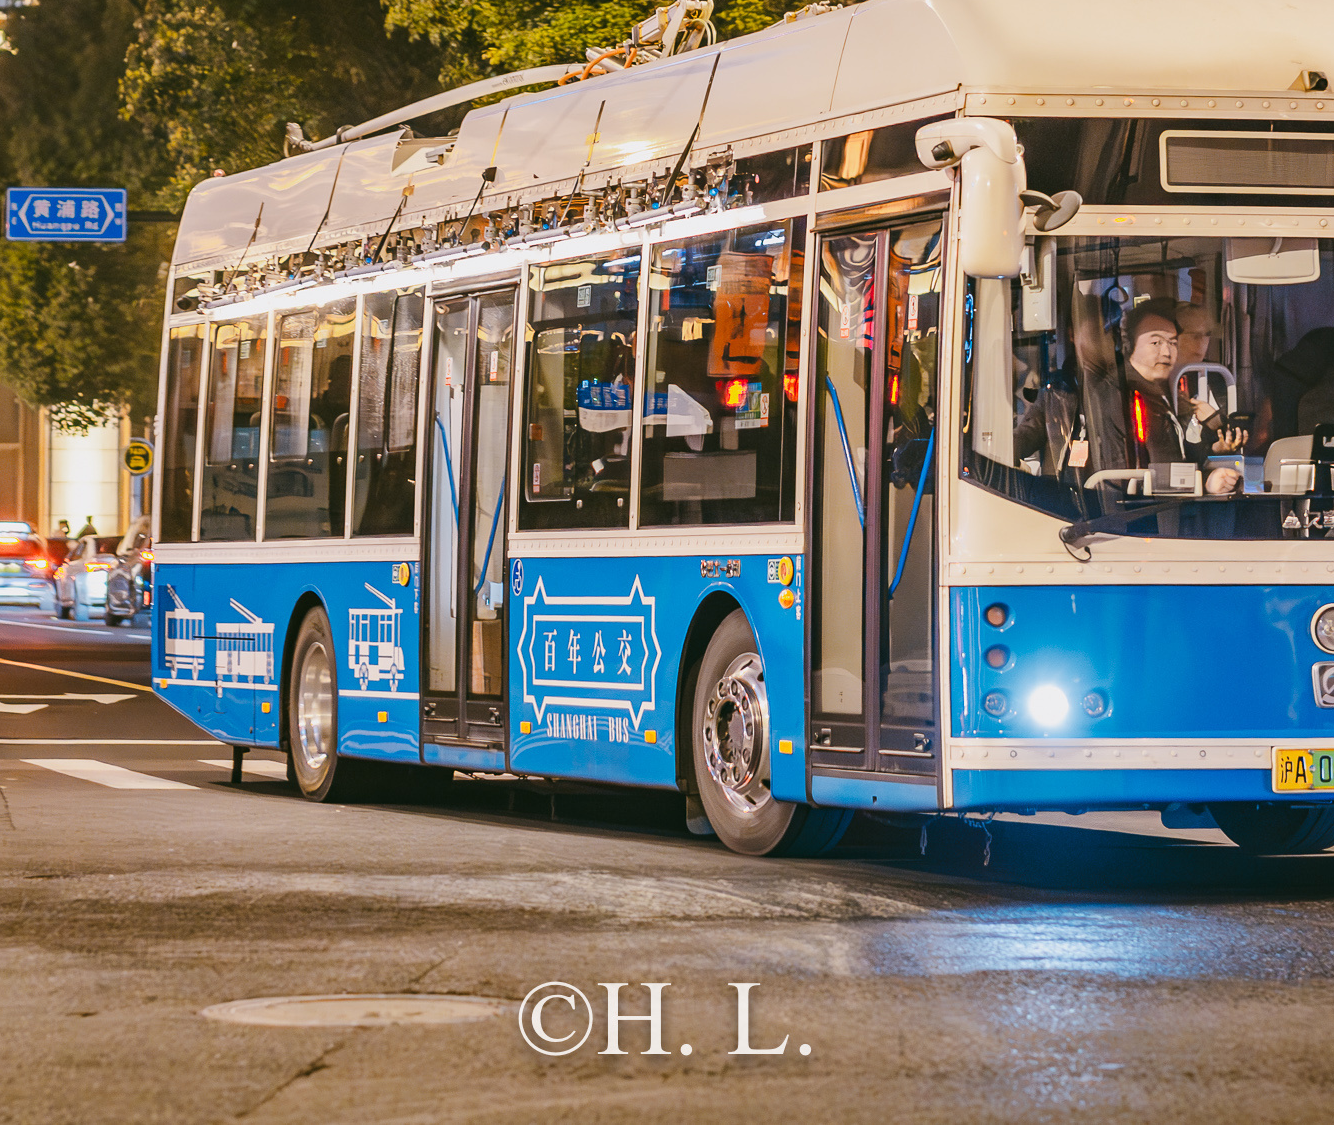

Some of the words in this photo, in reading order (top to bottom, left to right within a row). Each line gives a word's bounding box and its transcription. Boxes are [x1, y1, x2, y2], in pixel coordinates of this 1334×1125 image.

[33, 199, 100, 219] 黄浦路
[543, 628, 633, 676] 百年公交
[546, 712, 598, 741] SHANGHAI
[608, 716, 629, 743] BUS
